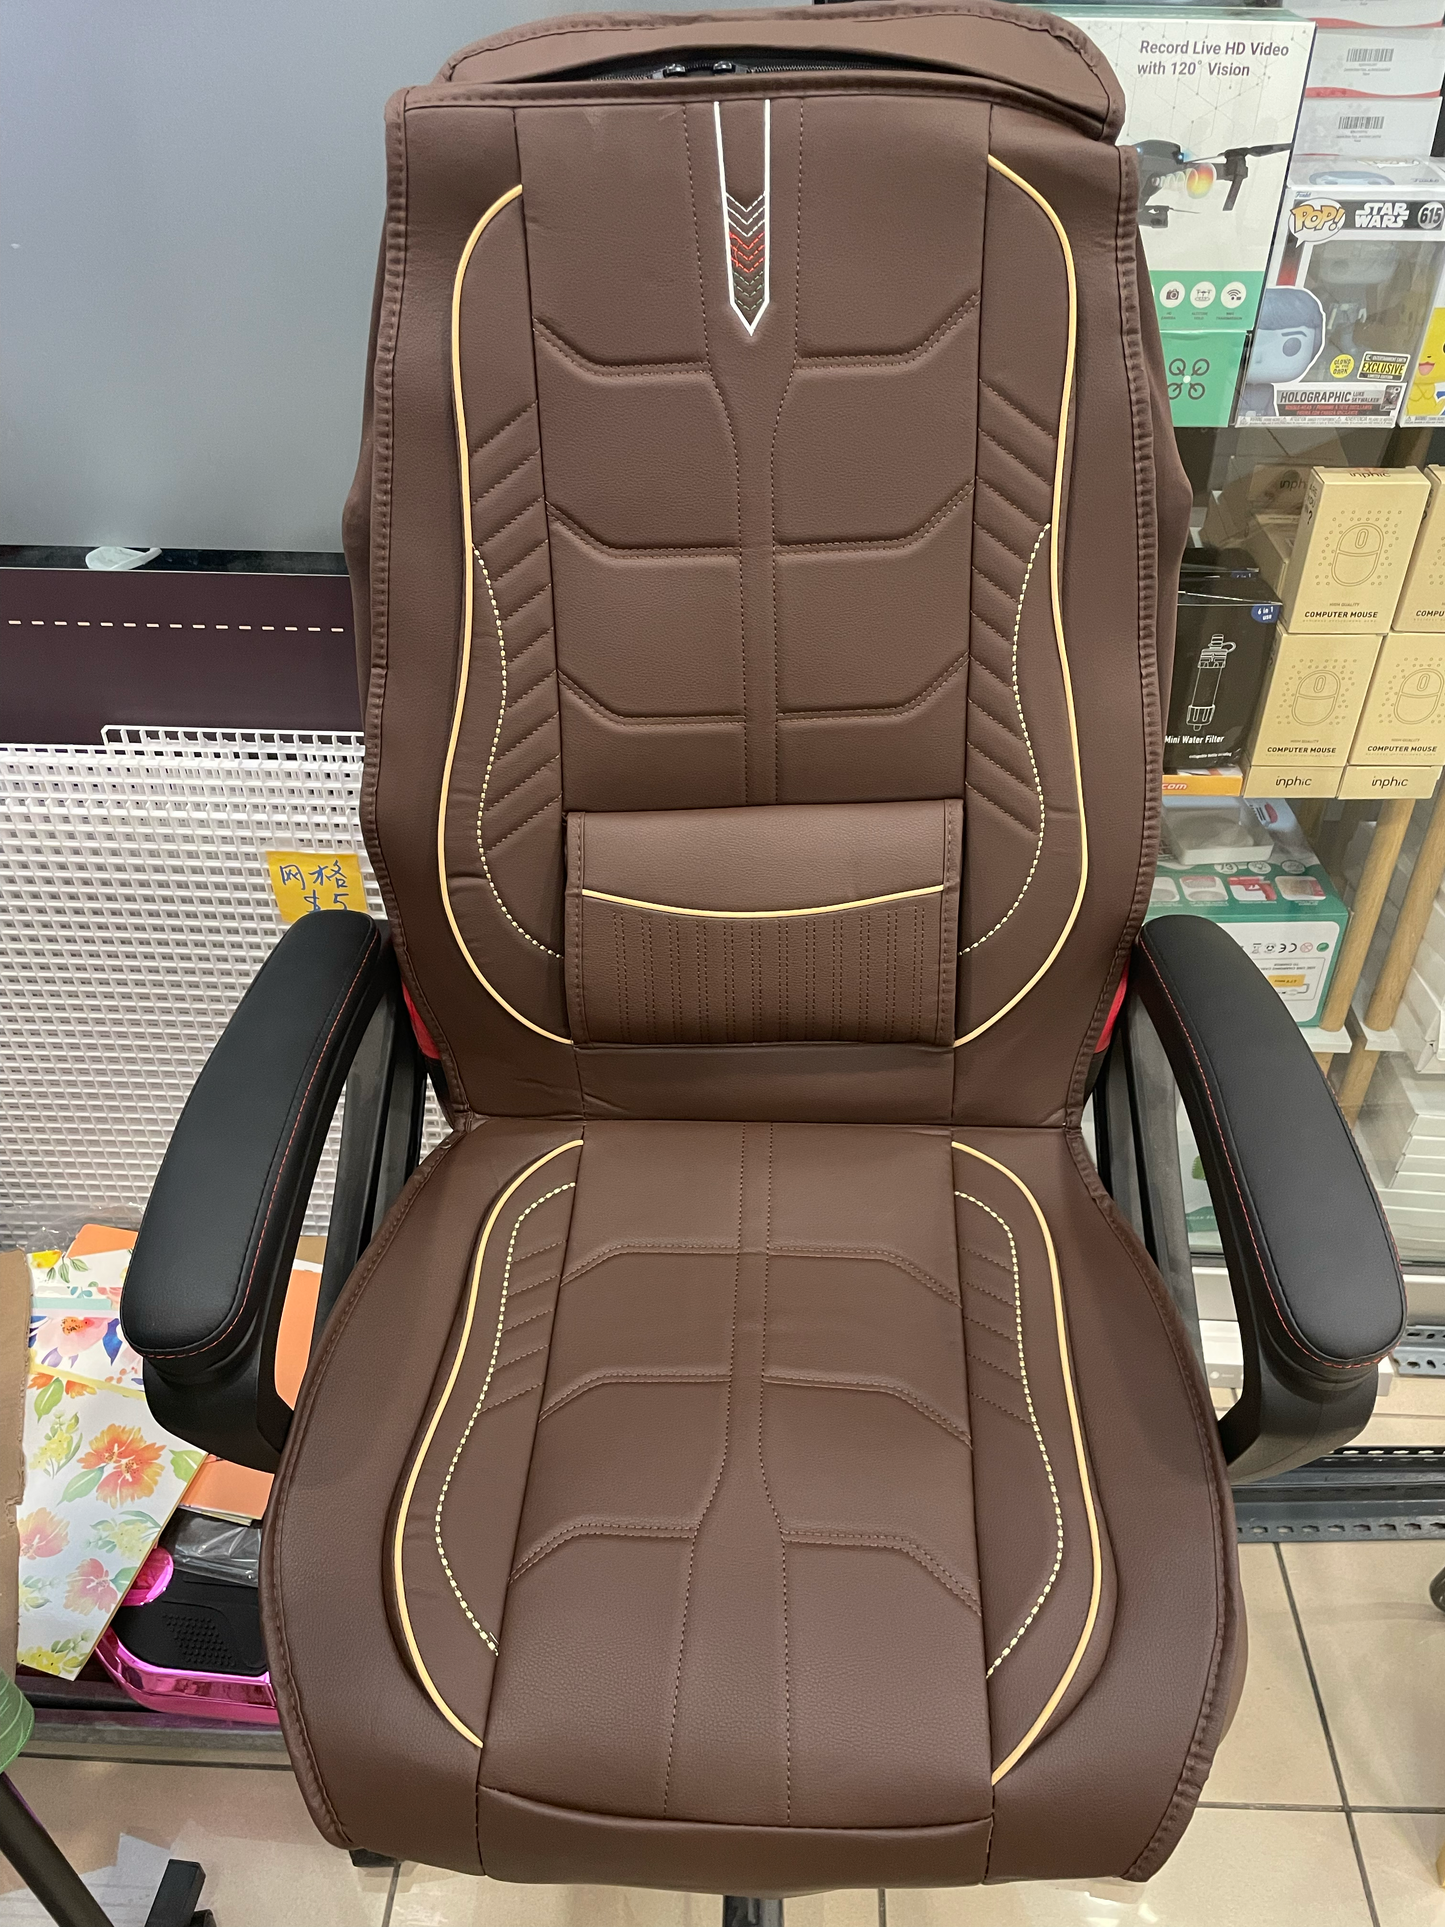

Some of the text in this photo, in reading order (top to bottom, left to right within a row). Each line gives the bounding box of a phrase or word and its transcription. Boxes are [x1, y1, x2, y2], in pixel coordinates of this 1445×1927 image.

[1139, 40, 1289, 56] Record Live HD Video
[1137, 60, 1250, 76] with 120° Vision
[1355, 203, 1410, 215] STAR
[1420, 206, 1443, 224] 615
[1290, 204, 1345, 234] POP!
[1355, 215, 1408, 228] WARS
[1361, 361, 1405, 375] EXCLUSIVE
[1280, 391, 1352, 403] HOLOGRAPHIC
[1164, 735, 1225, 744] Mini Water Filter
[1275, 775, 1312, 788] inphic
[1371, 776, 1409, 789] inphic
[280, 859, 349, 890] 网格
